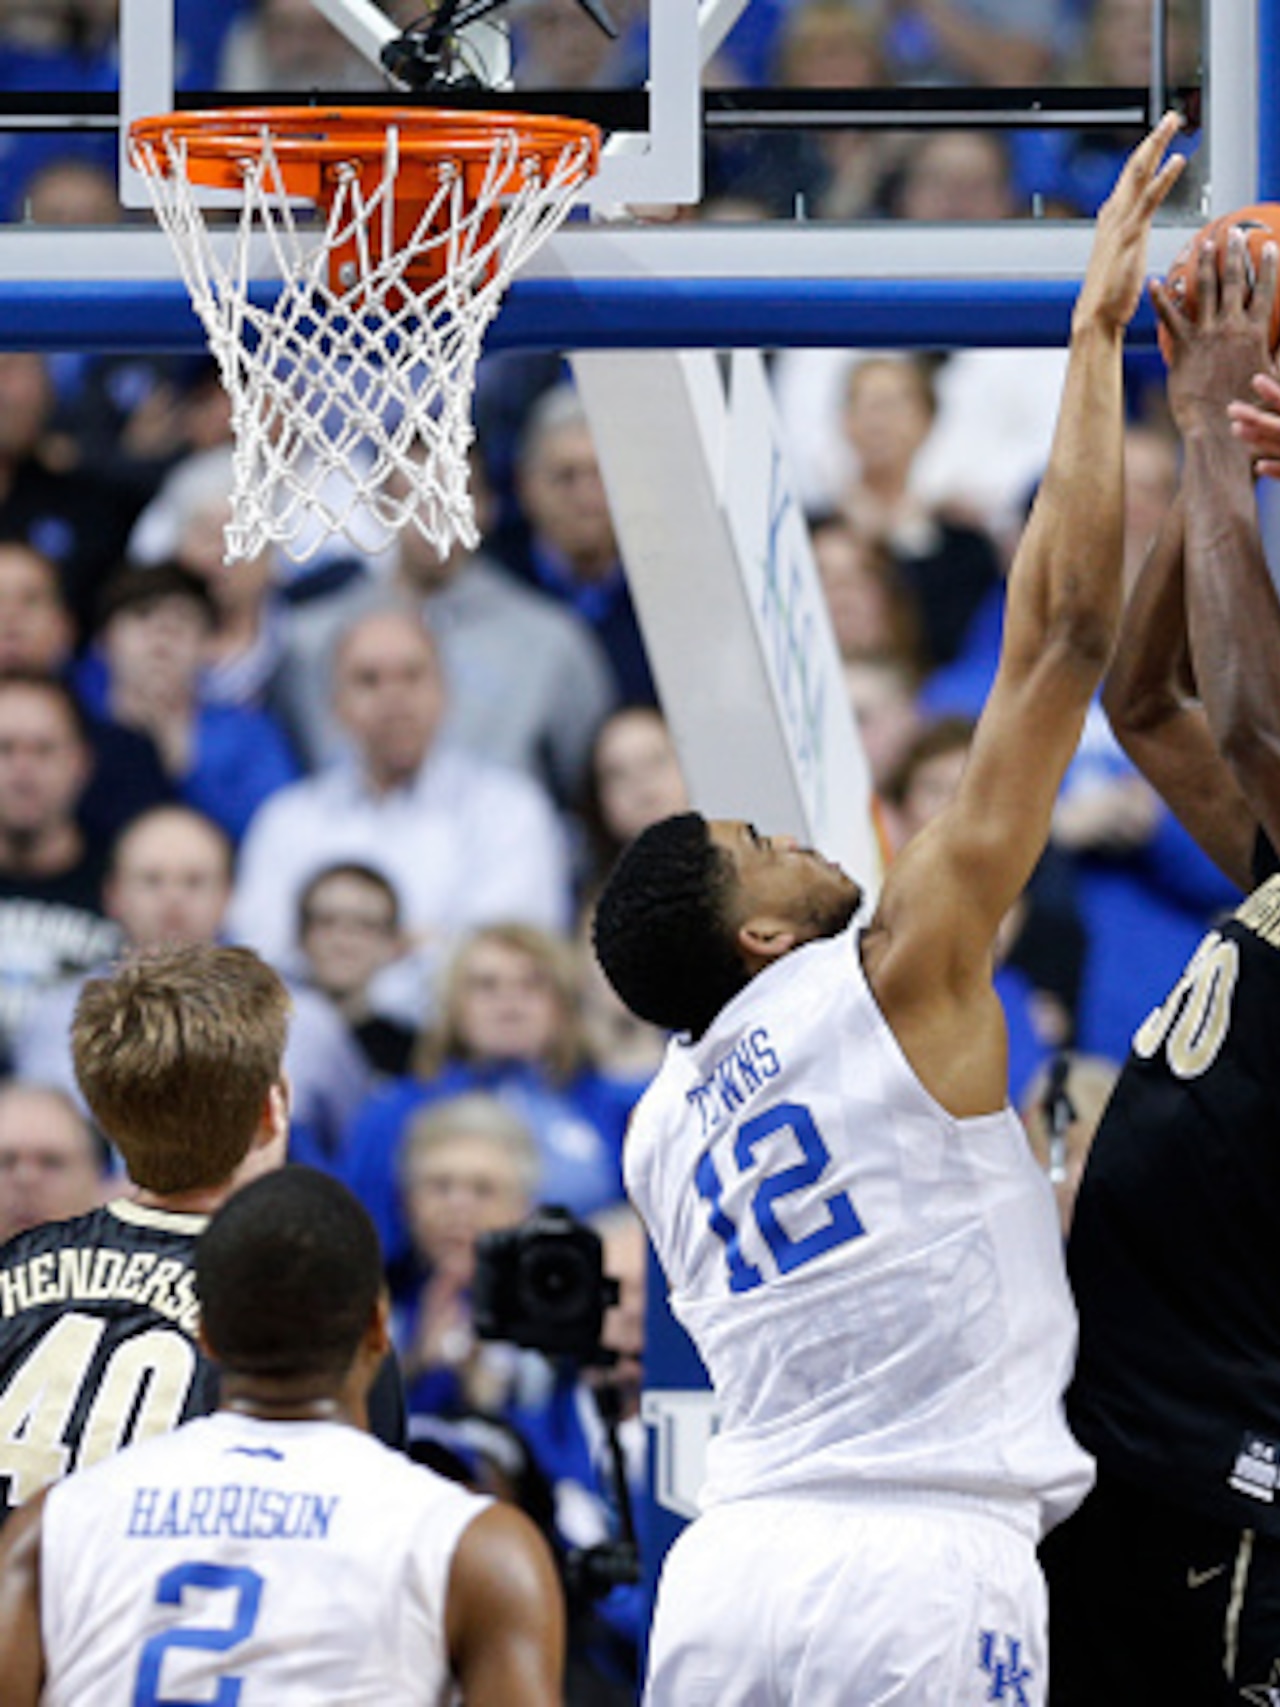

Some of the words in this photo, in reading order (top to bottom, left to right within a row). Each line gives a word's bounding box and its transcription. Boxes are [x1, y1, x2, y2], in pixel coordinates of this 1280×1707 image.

[694, 1099, 867, 1294] 12
[0, 1311, 197, 1507] 40
[126, 1483, 341, 1540] HARRISON
[132, 1561, 265, 1707] 2
